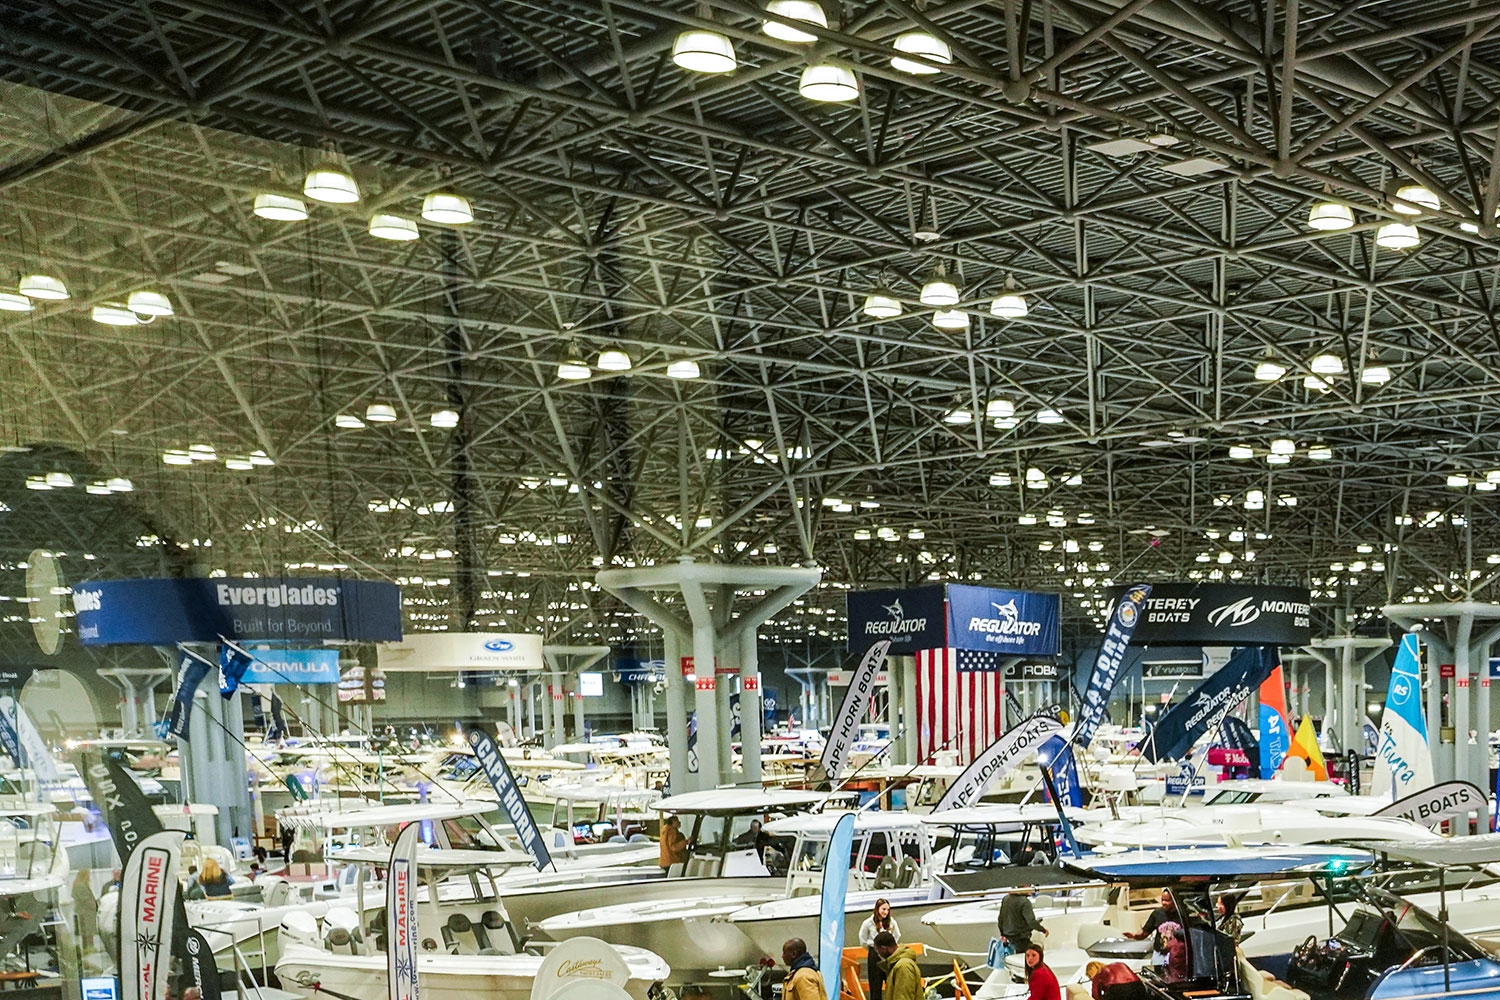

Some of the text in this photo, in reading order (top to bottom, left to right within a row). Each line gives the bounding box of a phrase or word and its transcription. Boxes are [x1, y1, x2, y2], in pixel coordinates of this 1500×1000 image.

[217, 584, 338, 608] Everglades
[1143, 598, 1200, 611] TEREY
[234, 618, 335, 636] Built for Beyond.
[865, 617, 927, 634] REGULATOR
[969, 617, 1041, 636] REGULATOR
[1148, 612, 1191, 623] BOATS
[1024, 665, 1057, 675] ROBA
[1393, 684, 1409, 697] RS
[825, 647, 882, 780] CAPE HORN BOATS
[1185, 686, 1231, 732] REGULATOR
[952, 721, 1050, 810] APE HORN BOATS
[477, 738, 536, 848] CAPE HORN
[1418, 788, 1470, 819] BOATS
[143, 856, 162, 923] MARINE
[557, 958, 603, 978] Castaways
